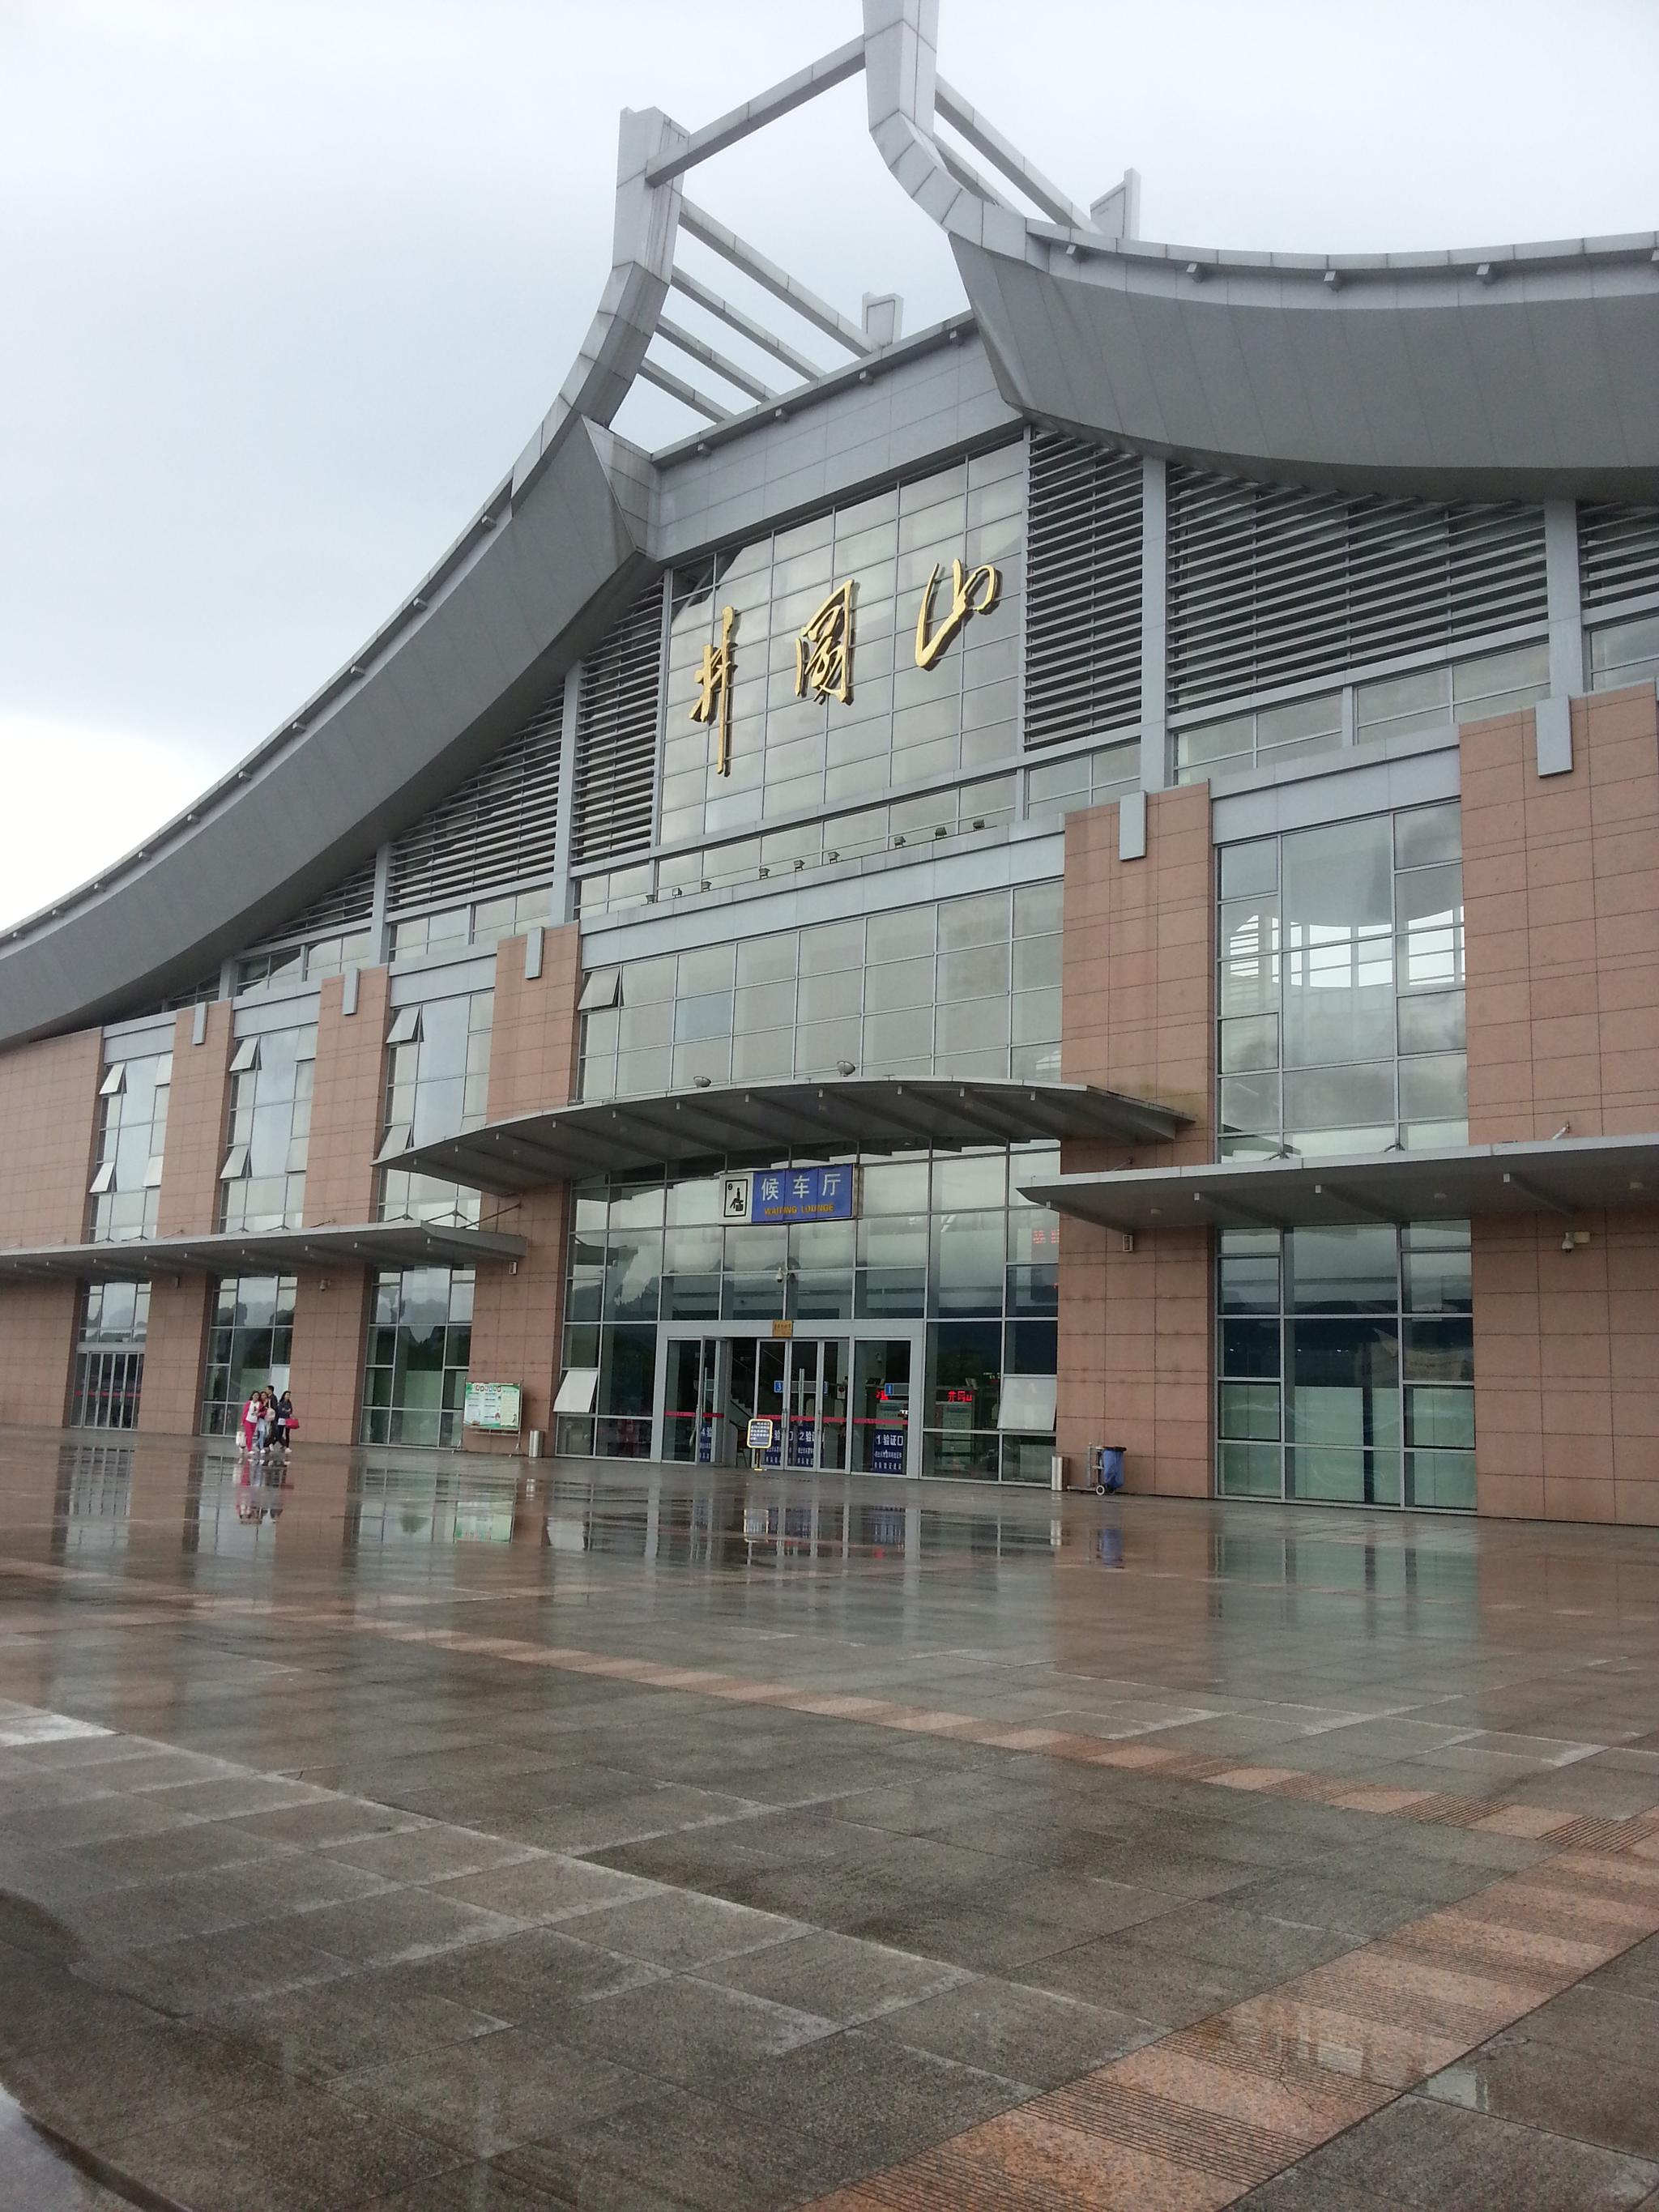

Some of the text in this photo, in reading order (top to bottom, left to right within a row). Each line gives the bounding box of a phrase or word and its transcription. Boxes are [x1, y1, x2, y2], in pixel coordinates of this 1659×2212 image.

[761, 1174, 841, 1201] 候车厅
[765, 1204, 834, 1215] WAITING LOUNGE
